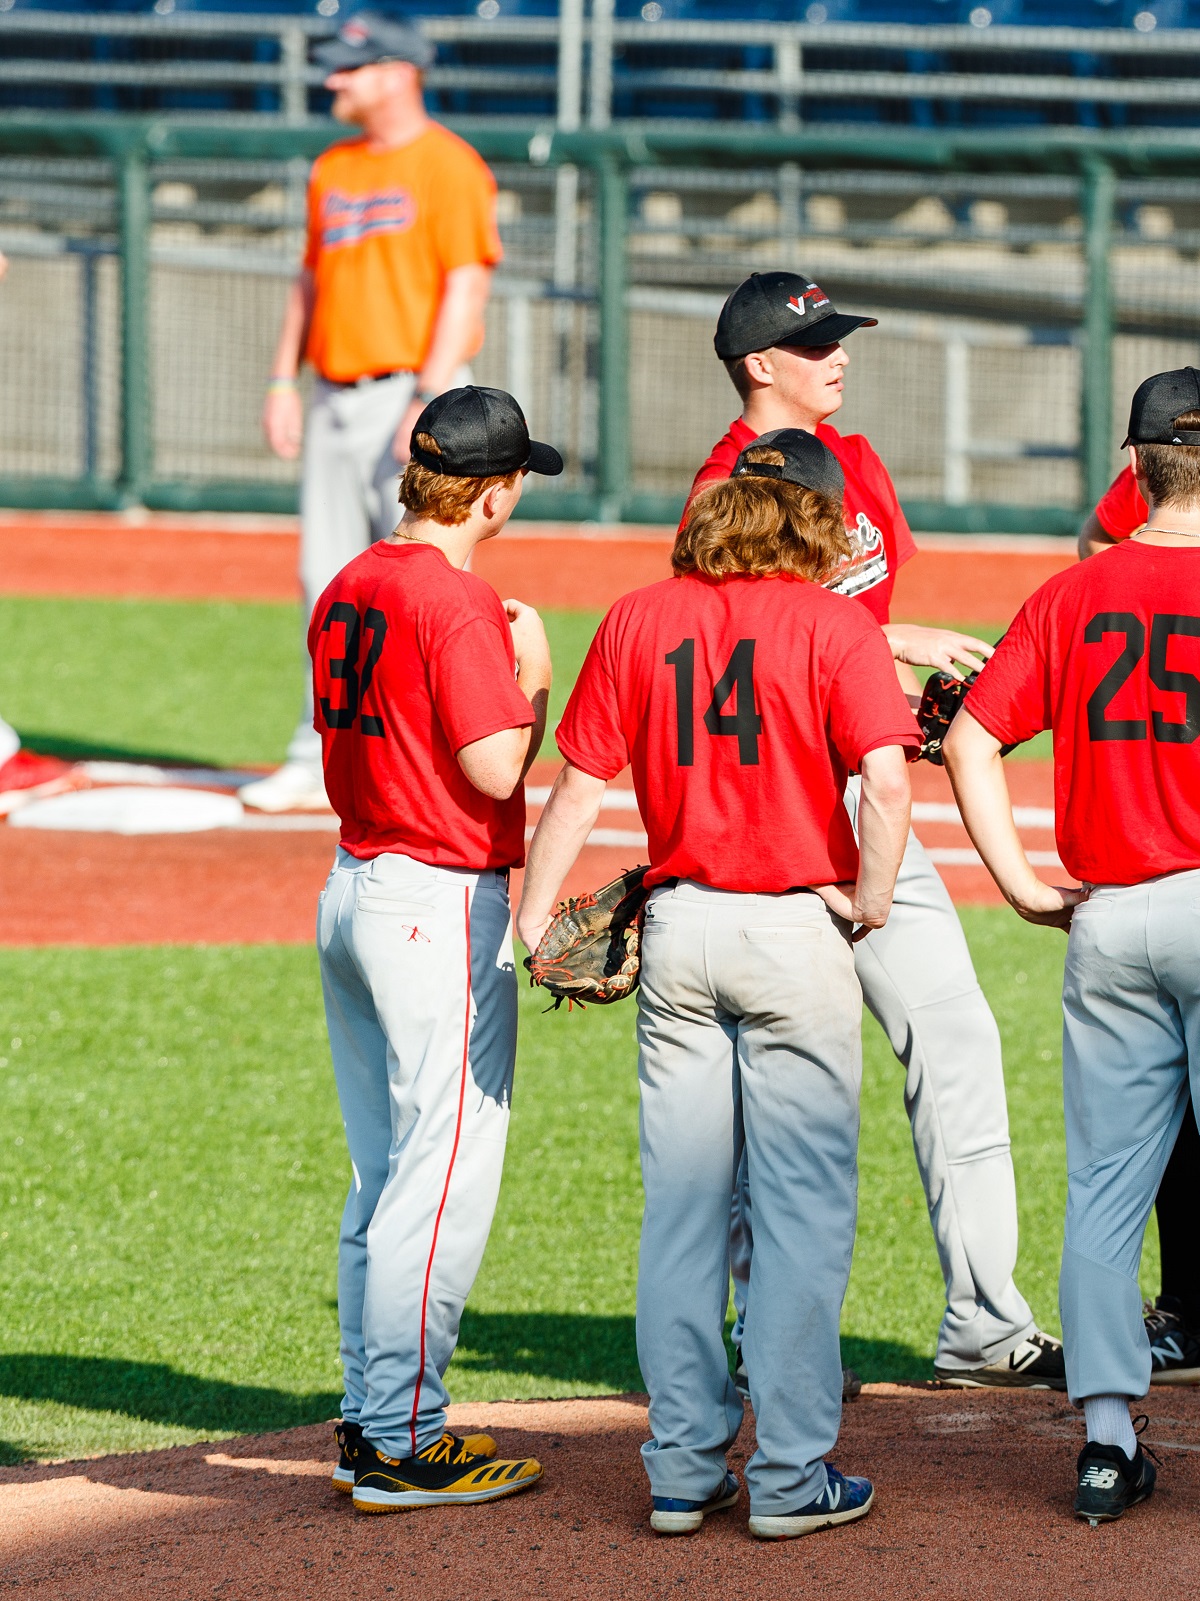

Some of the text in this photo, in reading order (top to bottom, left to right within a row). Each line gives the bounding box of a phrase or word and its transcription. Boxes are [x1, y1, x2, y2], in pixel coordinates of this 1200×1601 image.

[320, 602, 388, 738] 32
[665, 638, 762, 766] 14
[1080, 1467, 1118, 1489] NB
